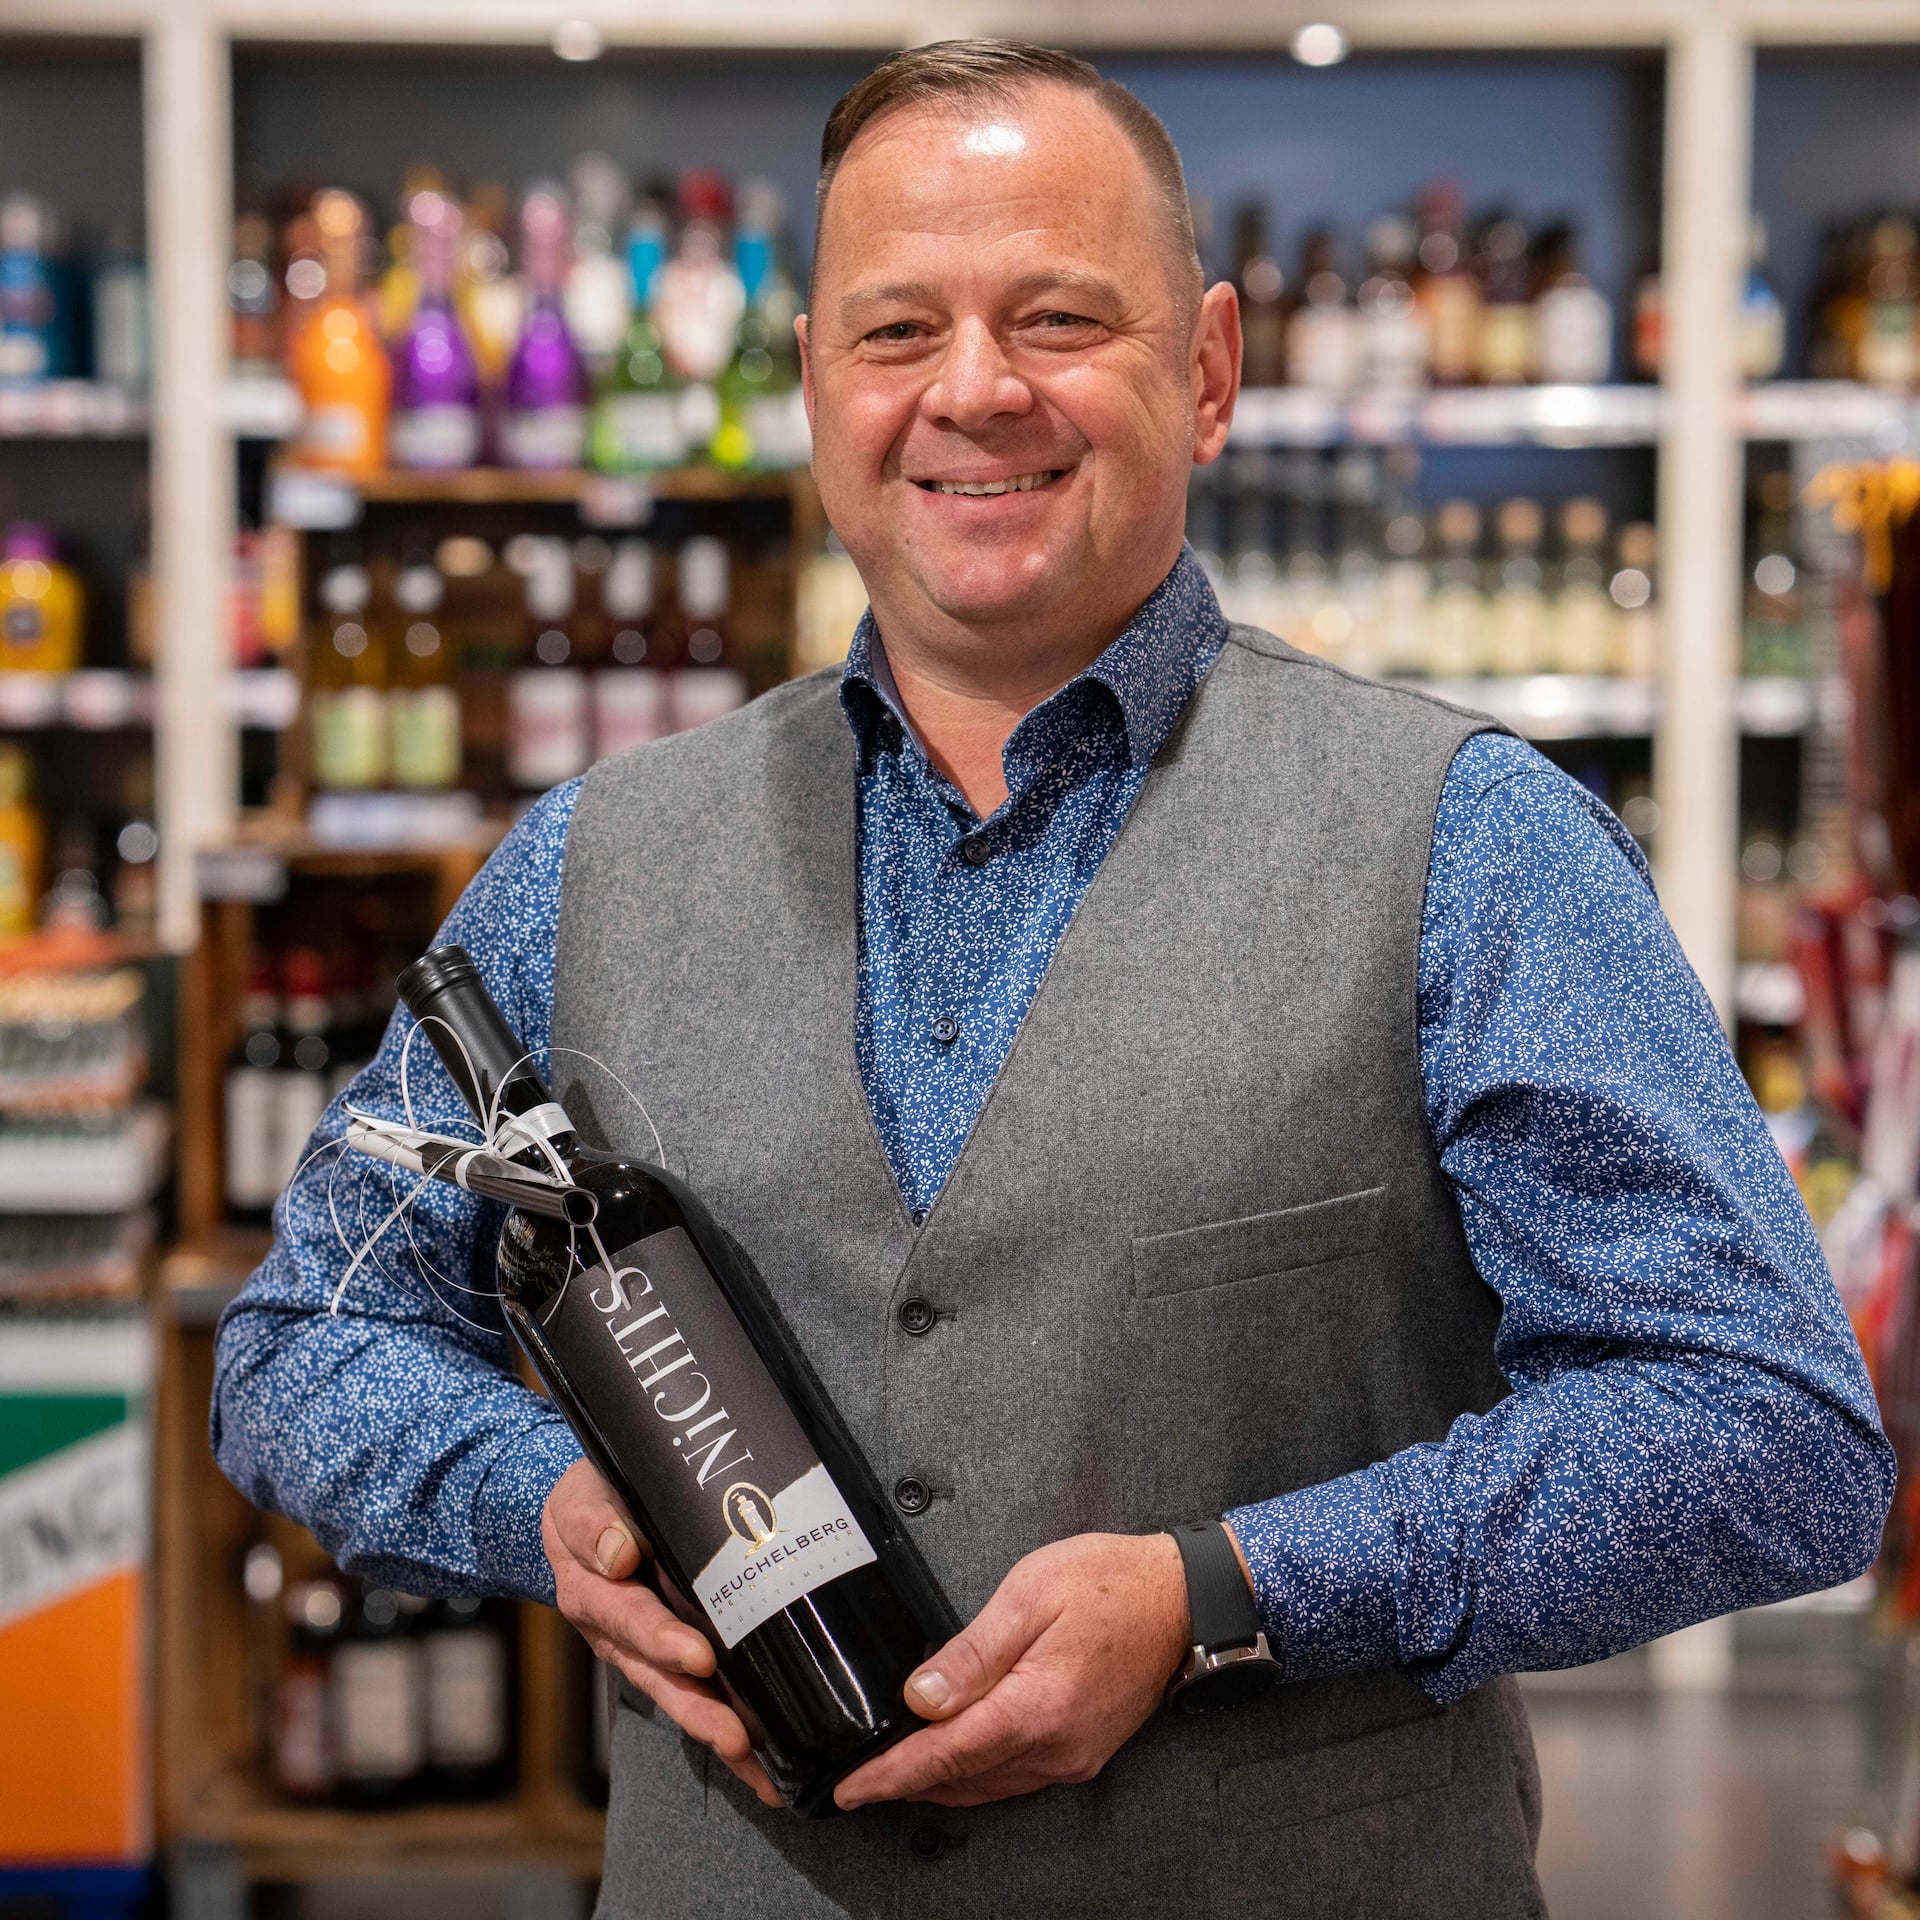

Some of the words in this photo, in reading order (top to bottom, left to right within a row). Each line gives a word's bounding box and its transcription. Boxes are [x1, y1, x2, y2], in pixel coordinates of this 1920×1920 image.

[589, 1266, 755, 1491] NiCHTS
[708, 1517, 850, 1609] HEUCHELBERG
[717, 1529, 854, 1616] WEINRER
